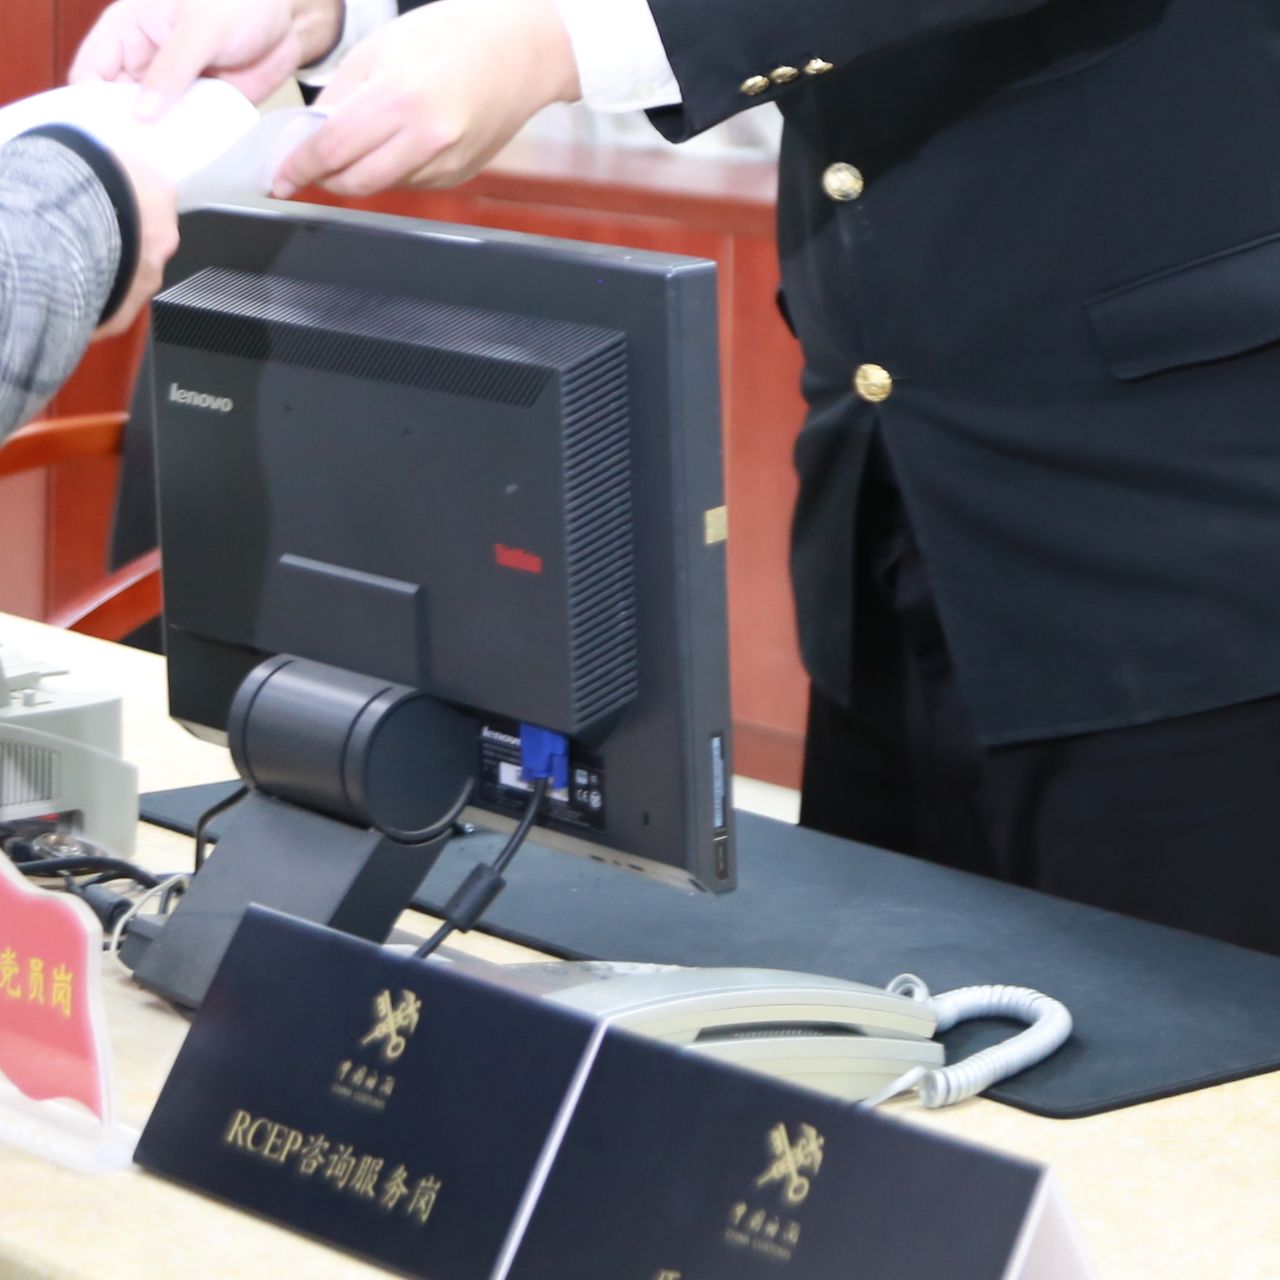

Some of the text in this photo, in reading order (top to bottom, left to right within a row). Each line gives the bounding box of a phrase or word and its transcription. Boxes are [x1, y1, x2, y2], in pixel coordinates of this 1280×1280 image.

[169, 381, 234, 412] lenovo
[226, 1109, 442, 1223] RCEP咨询服务岗
